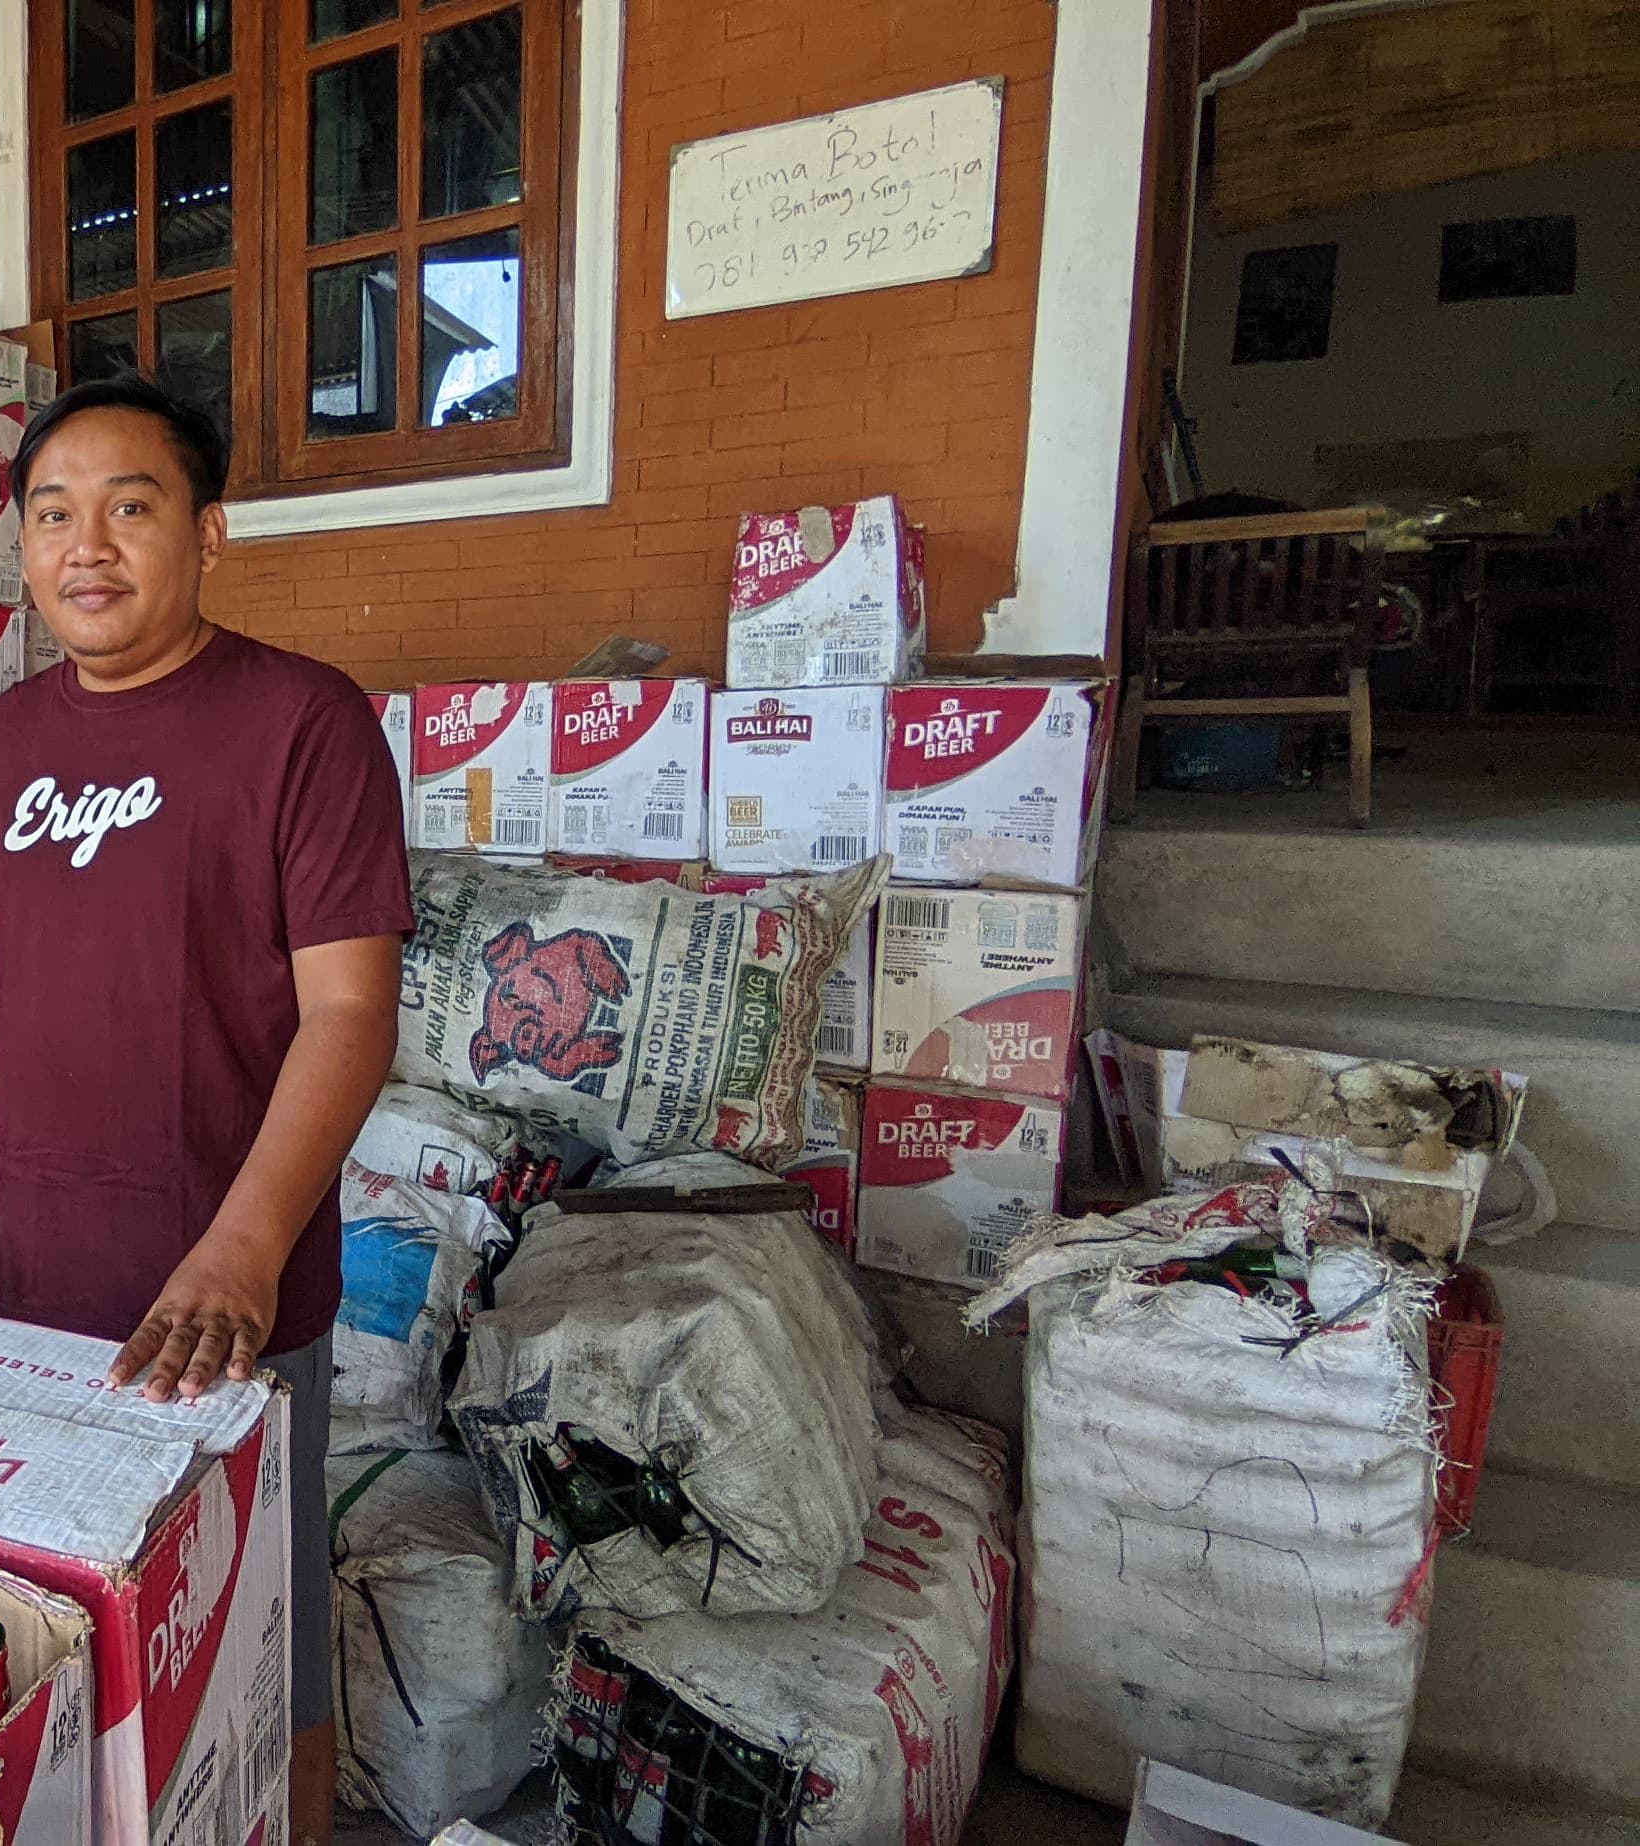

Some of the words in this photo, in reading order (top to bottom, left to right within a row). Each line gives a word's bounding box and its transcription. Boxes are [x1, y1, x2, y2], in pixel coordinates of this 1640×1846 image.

[842, 227, 890, 261] 542
[564, 705, 637, 735] DRAFT
[730, 719, 773, 736] BALI
[775, 718, 808, 734] HAI
[903, 710, 1003, 748] DRAFT
[1047, 714, 1059, 729] 12
[439, 726, 476, 746] BEER
[580, 724, 619, 746] BEER
[924, 737, 974, 761] BEER
[4, 776, 162, 868] Erigo
[729, 806, 758, 817] BEER
[725, 829, 783, 840] CELEBRATE
[429, 959, 453, 1012] ANAK
[751, 974, 768, 992] KG
[743, 1002, 766, 1028] 50
[425, 1009, 448, 1064] PAKAN
[665, 996, 699, 1084] POKPHAND
[878, 1120, 976, 1144] DRAFT
[1020, 1128, 1034, 1142] 12
[898, 1143, 946, 1159] BEER
[261, 1461, 271, 1486] 12
[50, 1717, 68, 1743] 12
